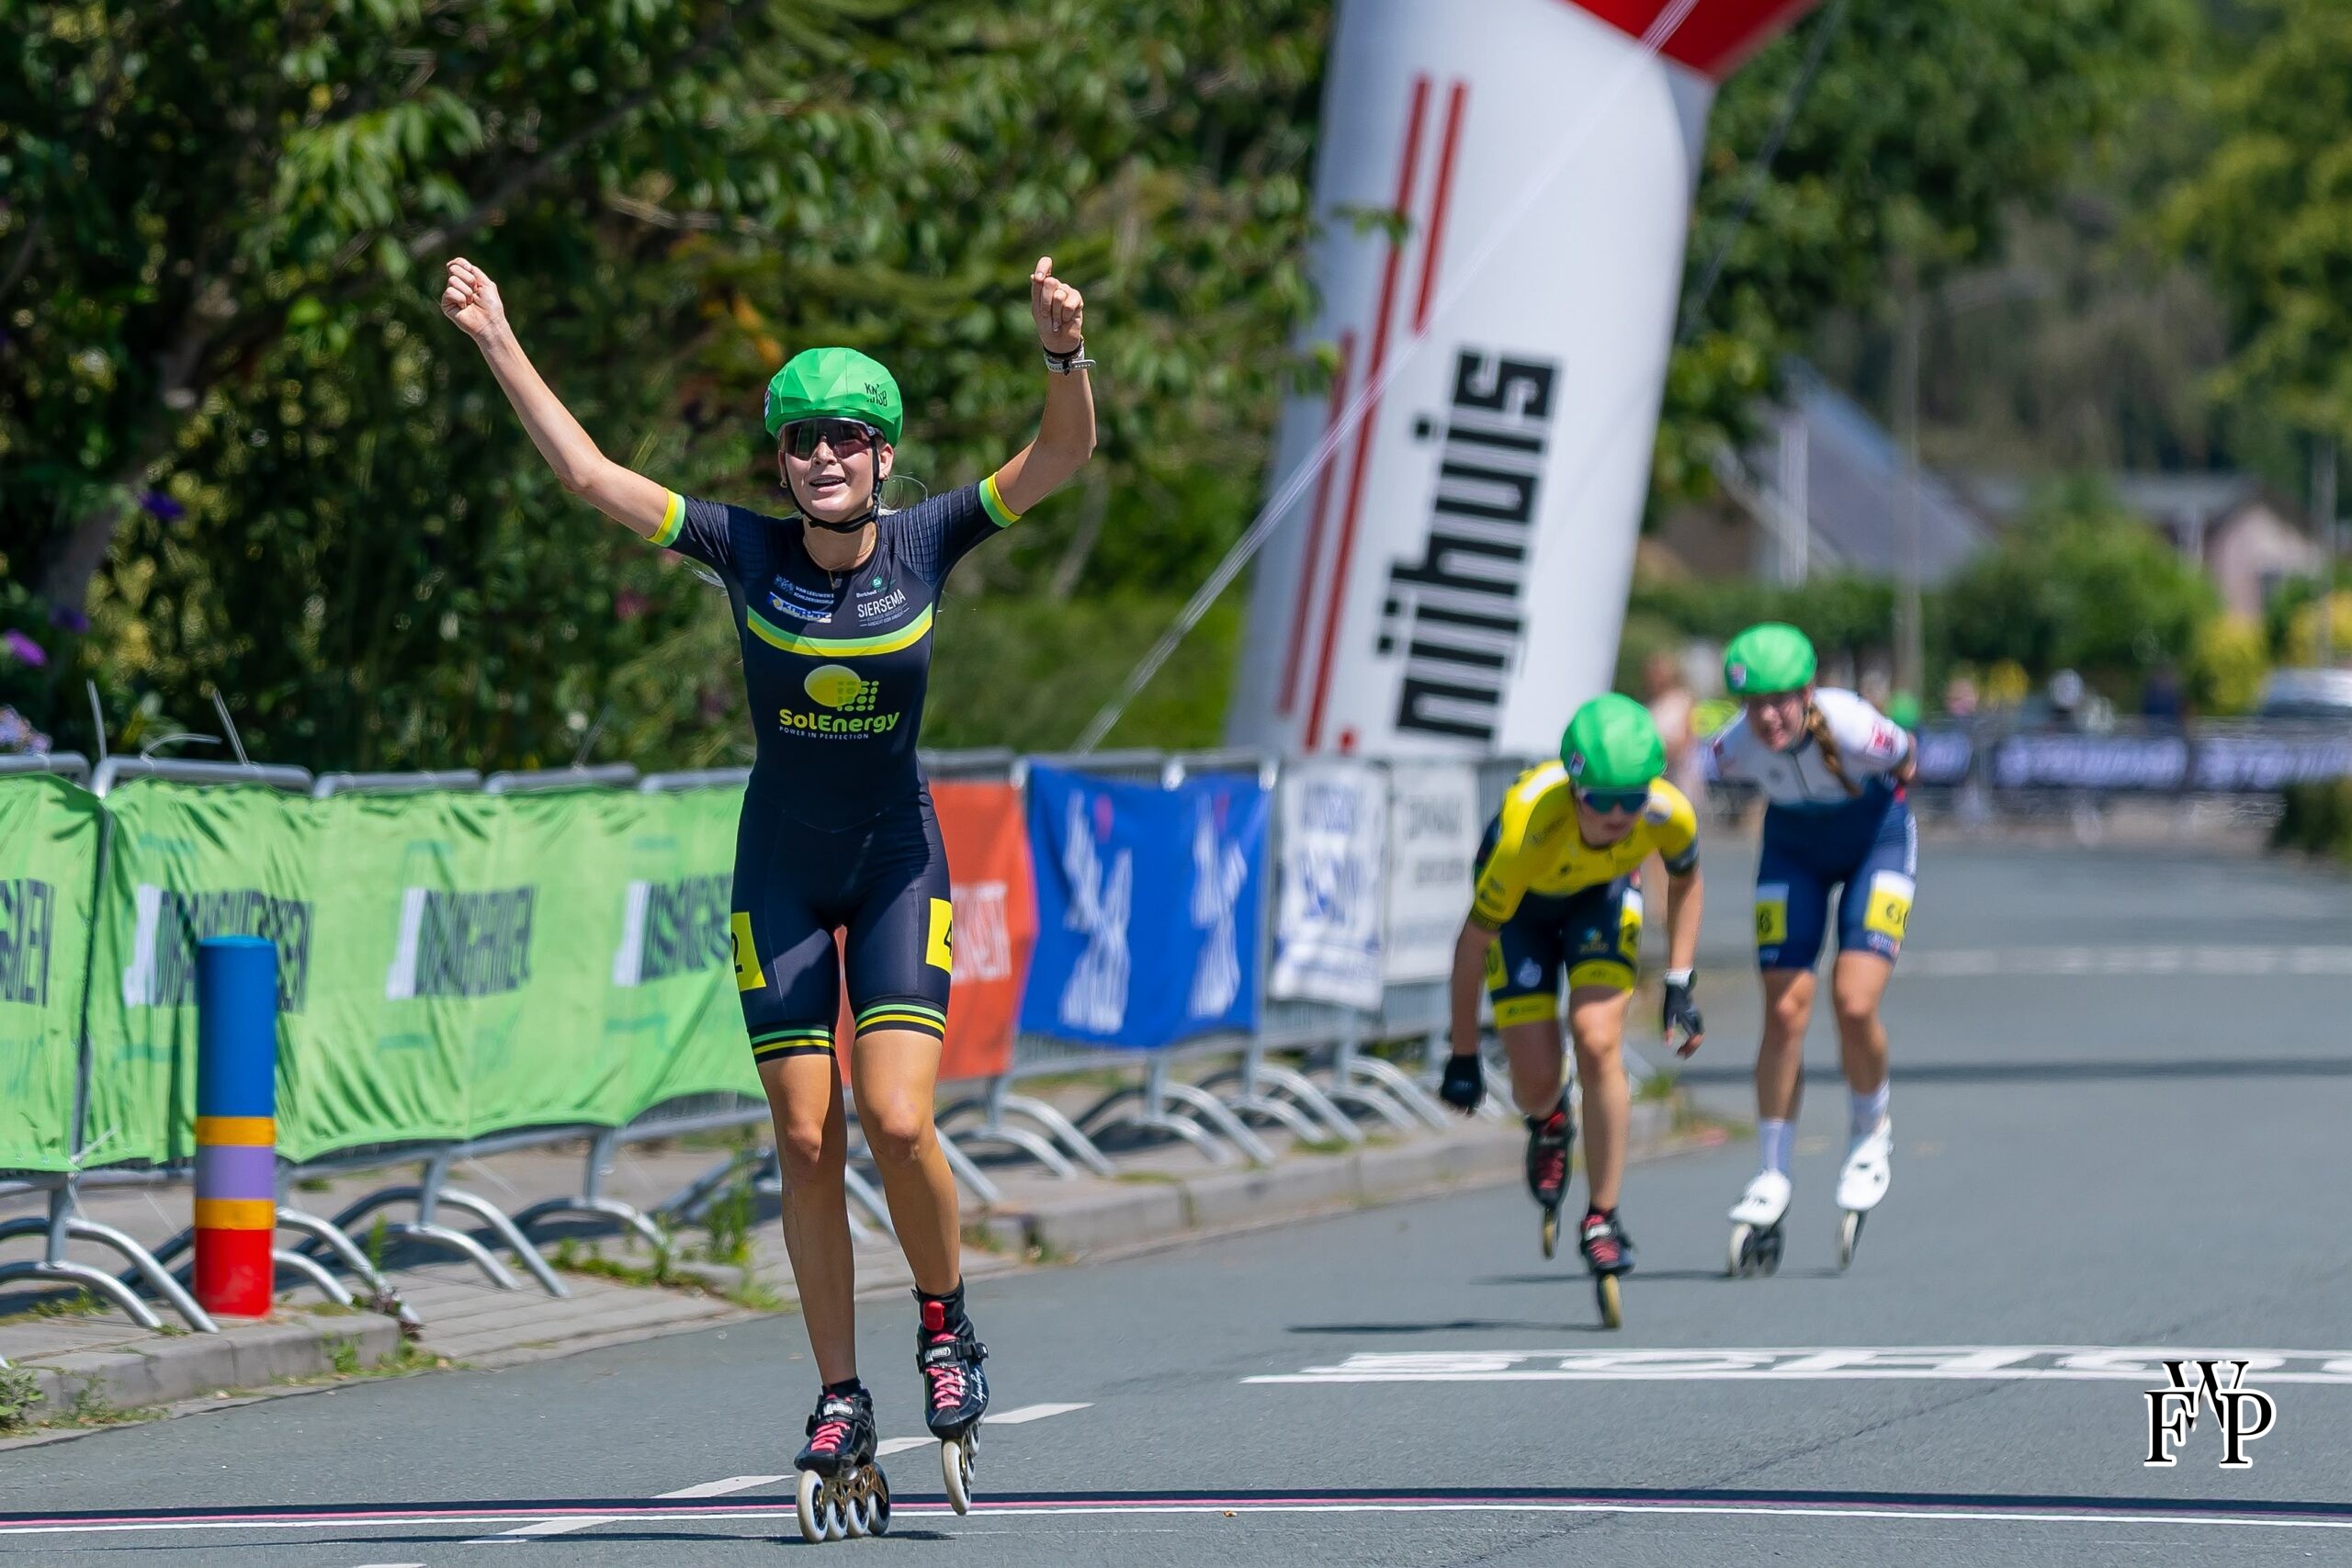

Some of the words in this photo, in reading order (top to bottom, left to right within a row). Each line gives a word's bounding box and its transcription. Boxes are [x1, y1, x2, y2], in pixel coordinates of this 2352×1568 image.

[1378, 349, 1557, 741] nijhuis
[857, 588, 906, 618] SIERSEMA
[779, 708, 900, 733] SolEnergy
[779, 726, 805, 736] POWER
